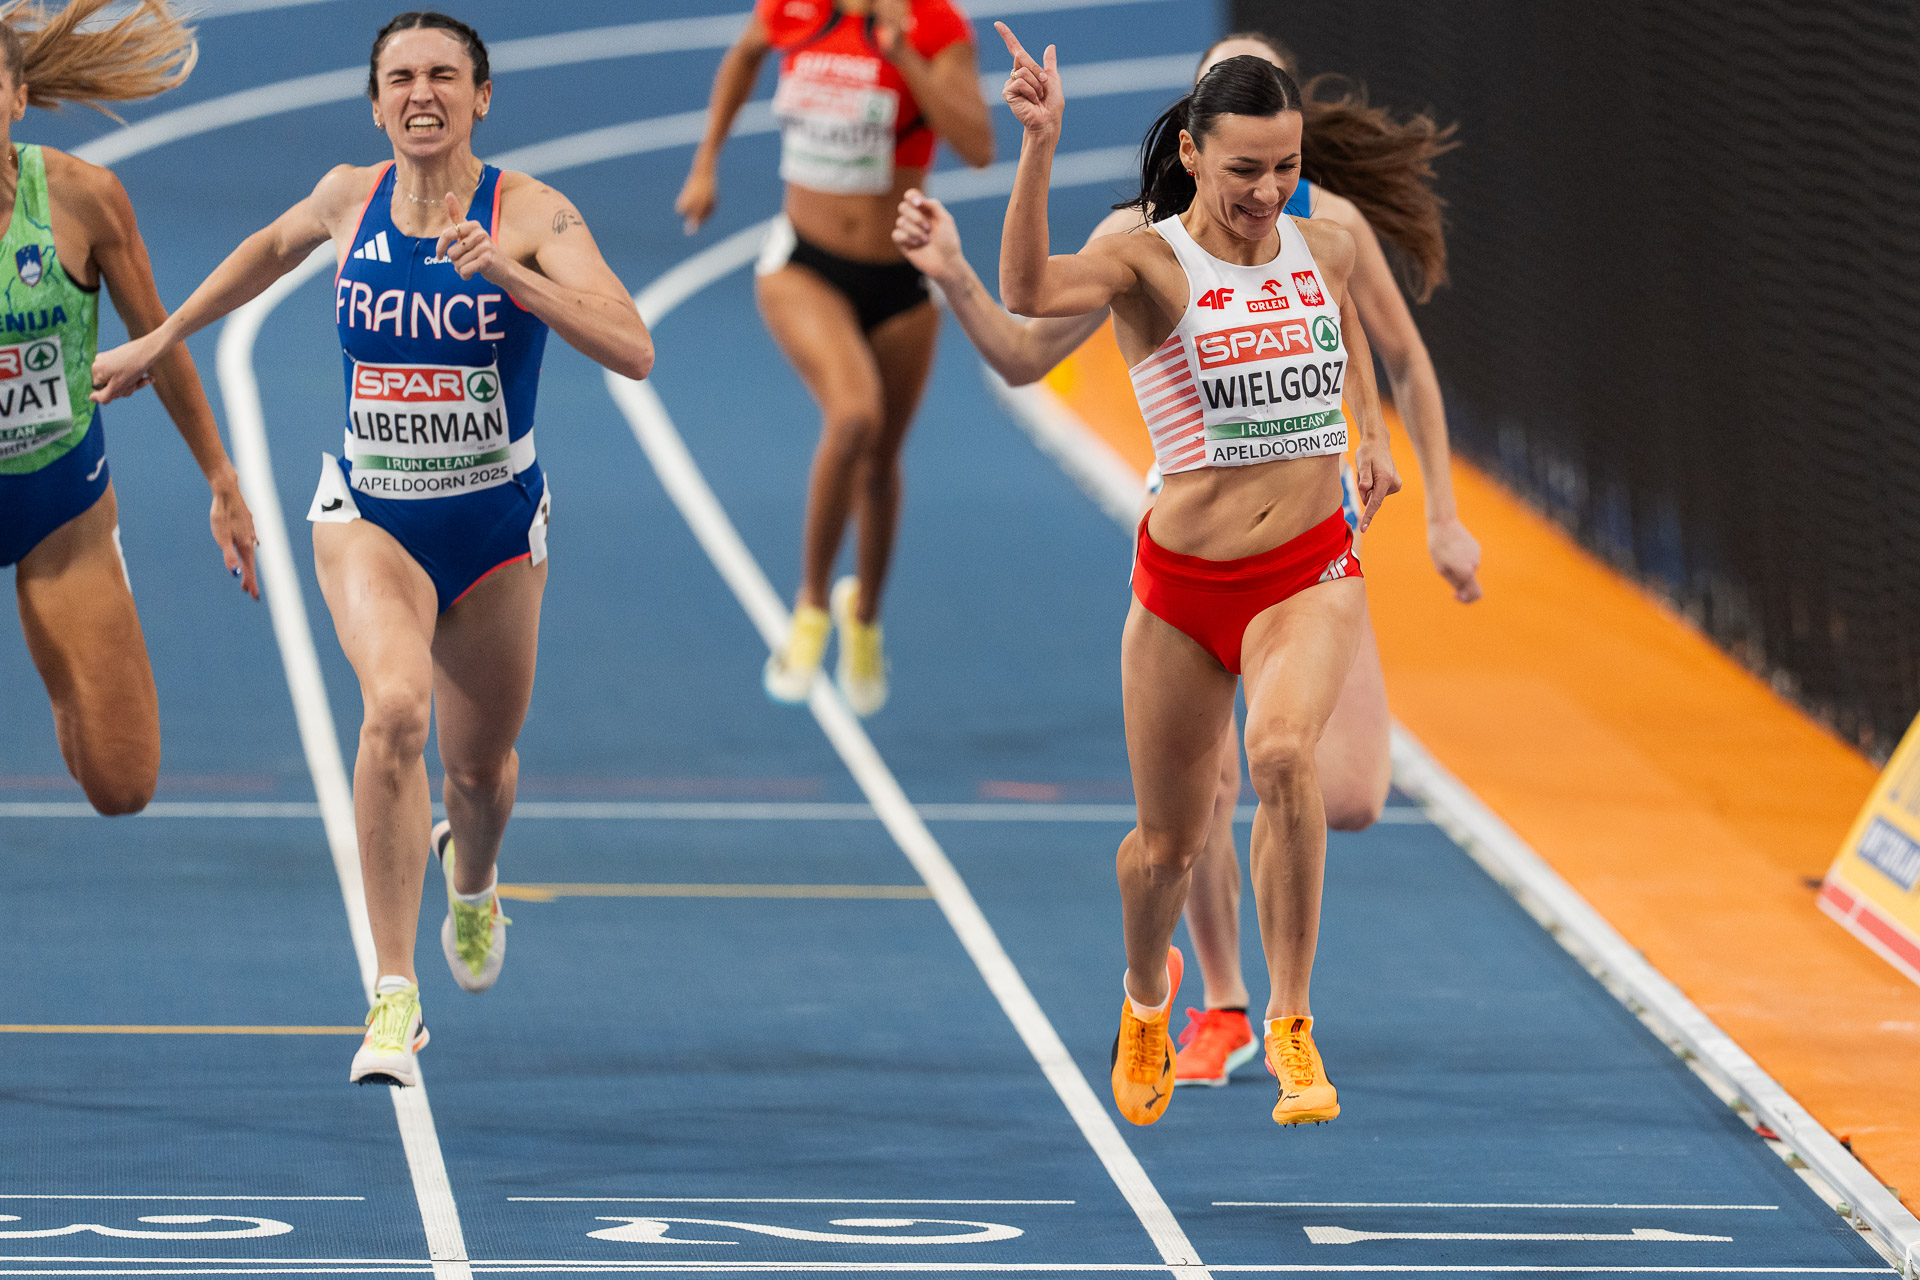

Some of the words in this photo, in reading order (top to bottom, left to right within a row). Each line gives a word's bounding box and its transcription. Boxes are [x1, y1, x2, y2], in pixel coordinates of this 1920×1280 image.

[336, 279, 505, 341] FRANCE
[1197, 287, 1234, 309] 4F
[1250, 299, 1287, 312] ORLEN
[1201, 323, 1309, 364] SPAR
[358, 371, 462, 398] SPAR
[1202, 361, 1344, 408] WIELGOSZ
[353, 408, 503, 445] LIBERMAN
[1241, 424, 1245, 436] I
[1248, 421, 1283, 435] RUN
[1213, 437, 1320, 462] APELDOORN
[1324, 431, 1347, 448] 2025
[386, 456, 391, 468] I
[393, 457, 425, 471] RUN
[358, 477, 465, 492] APELDOORN
[470, 466, 509, 485] 2025
[586, 1215, 1024, 1245] 2
[1304, 1225, 1734, 1245] 1
